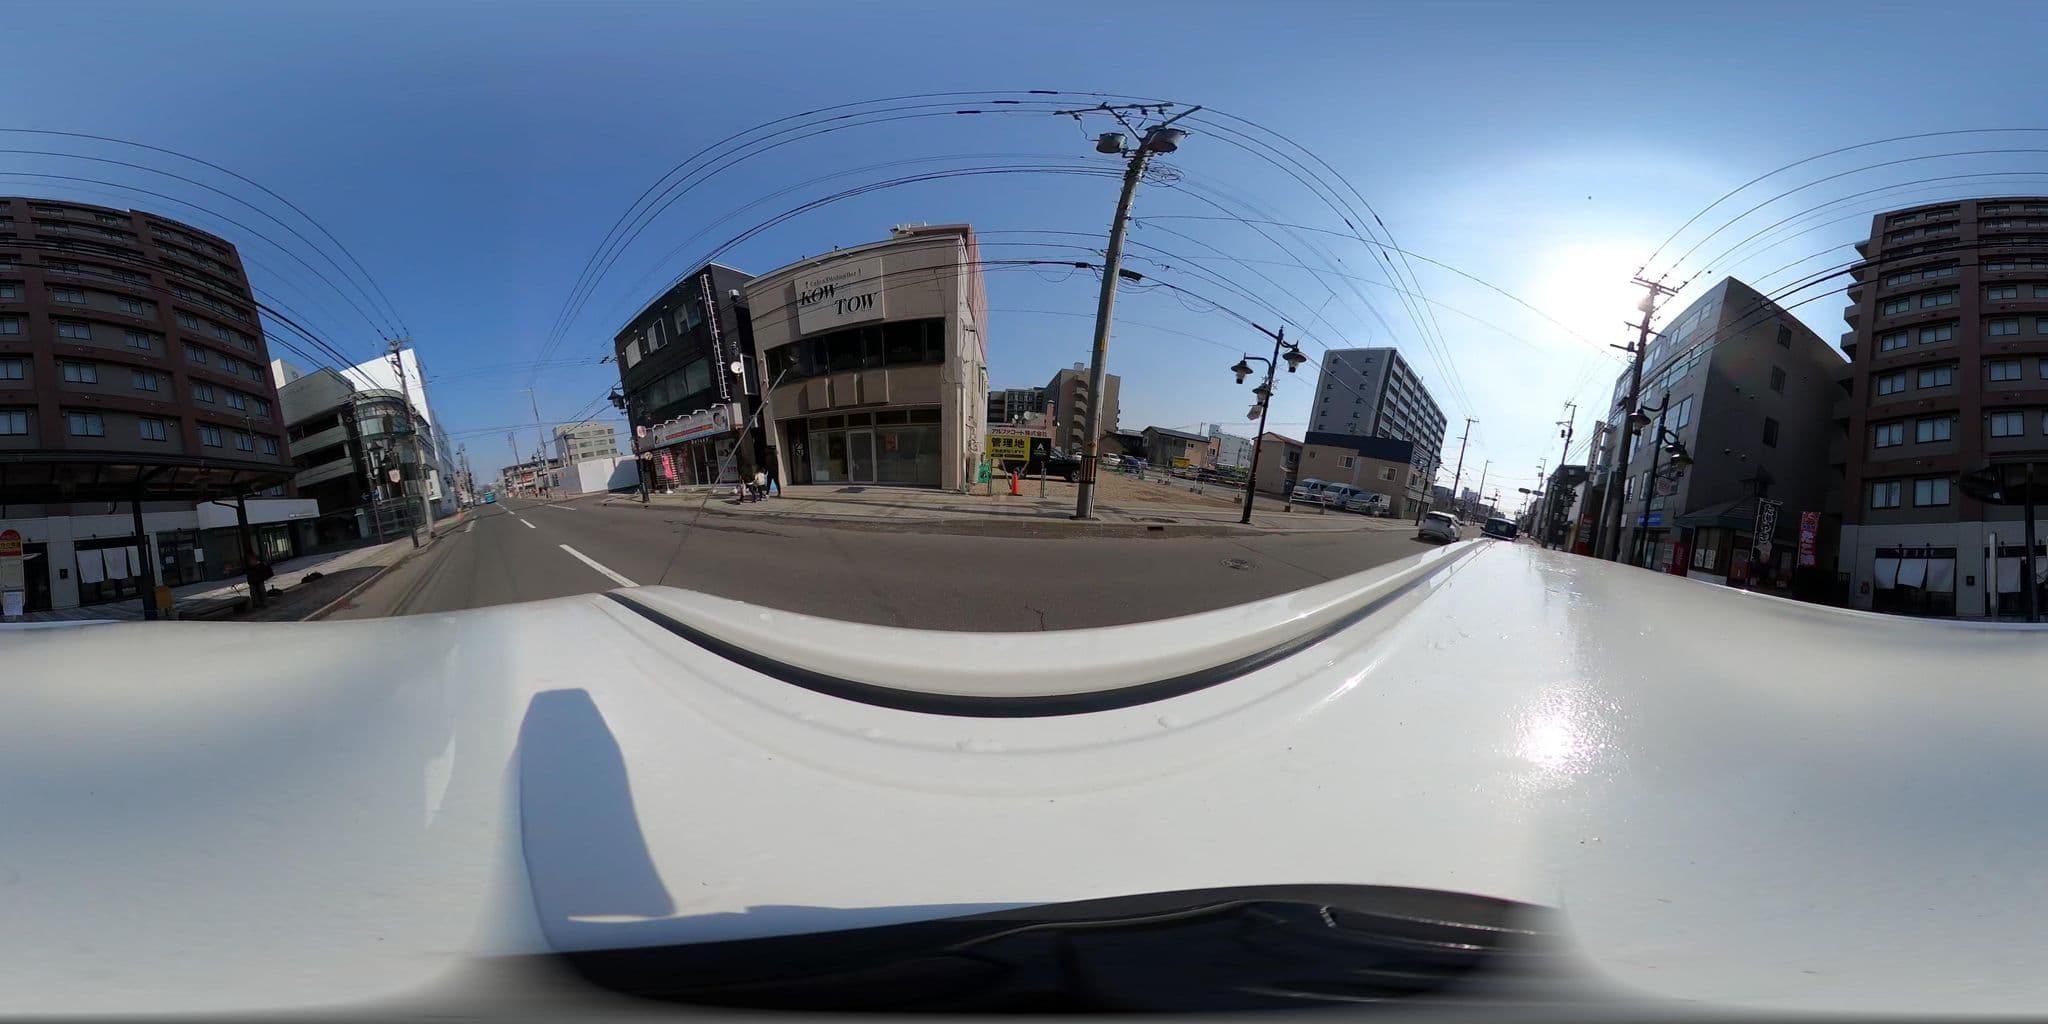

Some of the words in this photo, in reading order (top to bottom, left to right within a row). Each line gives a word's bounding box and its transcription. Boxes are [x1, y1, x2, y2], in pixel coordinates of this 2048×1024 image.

[801, 283, 838, 306] KOW
[835, 293, 877, 315] TOW
[991, 437, 1025, 448] 管理地
